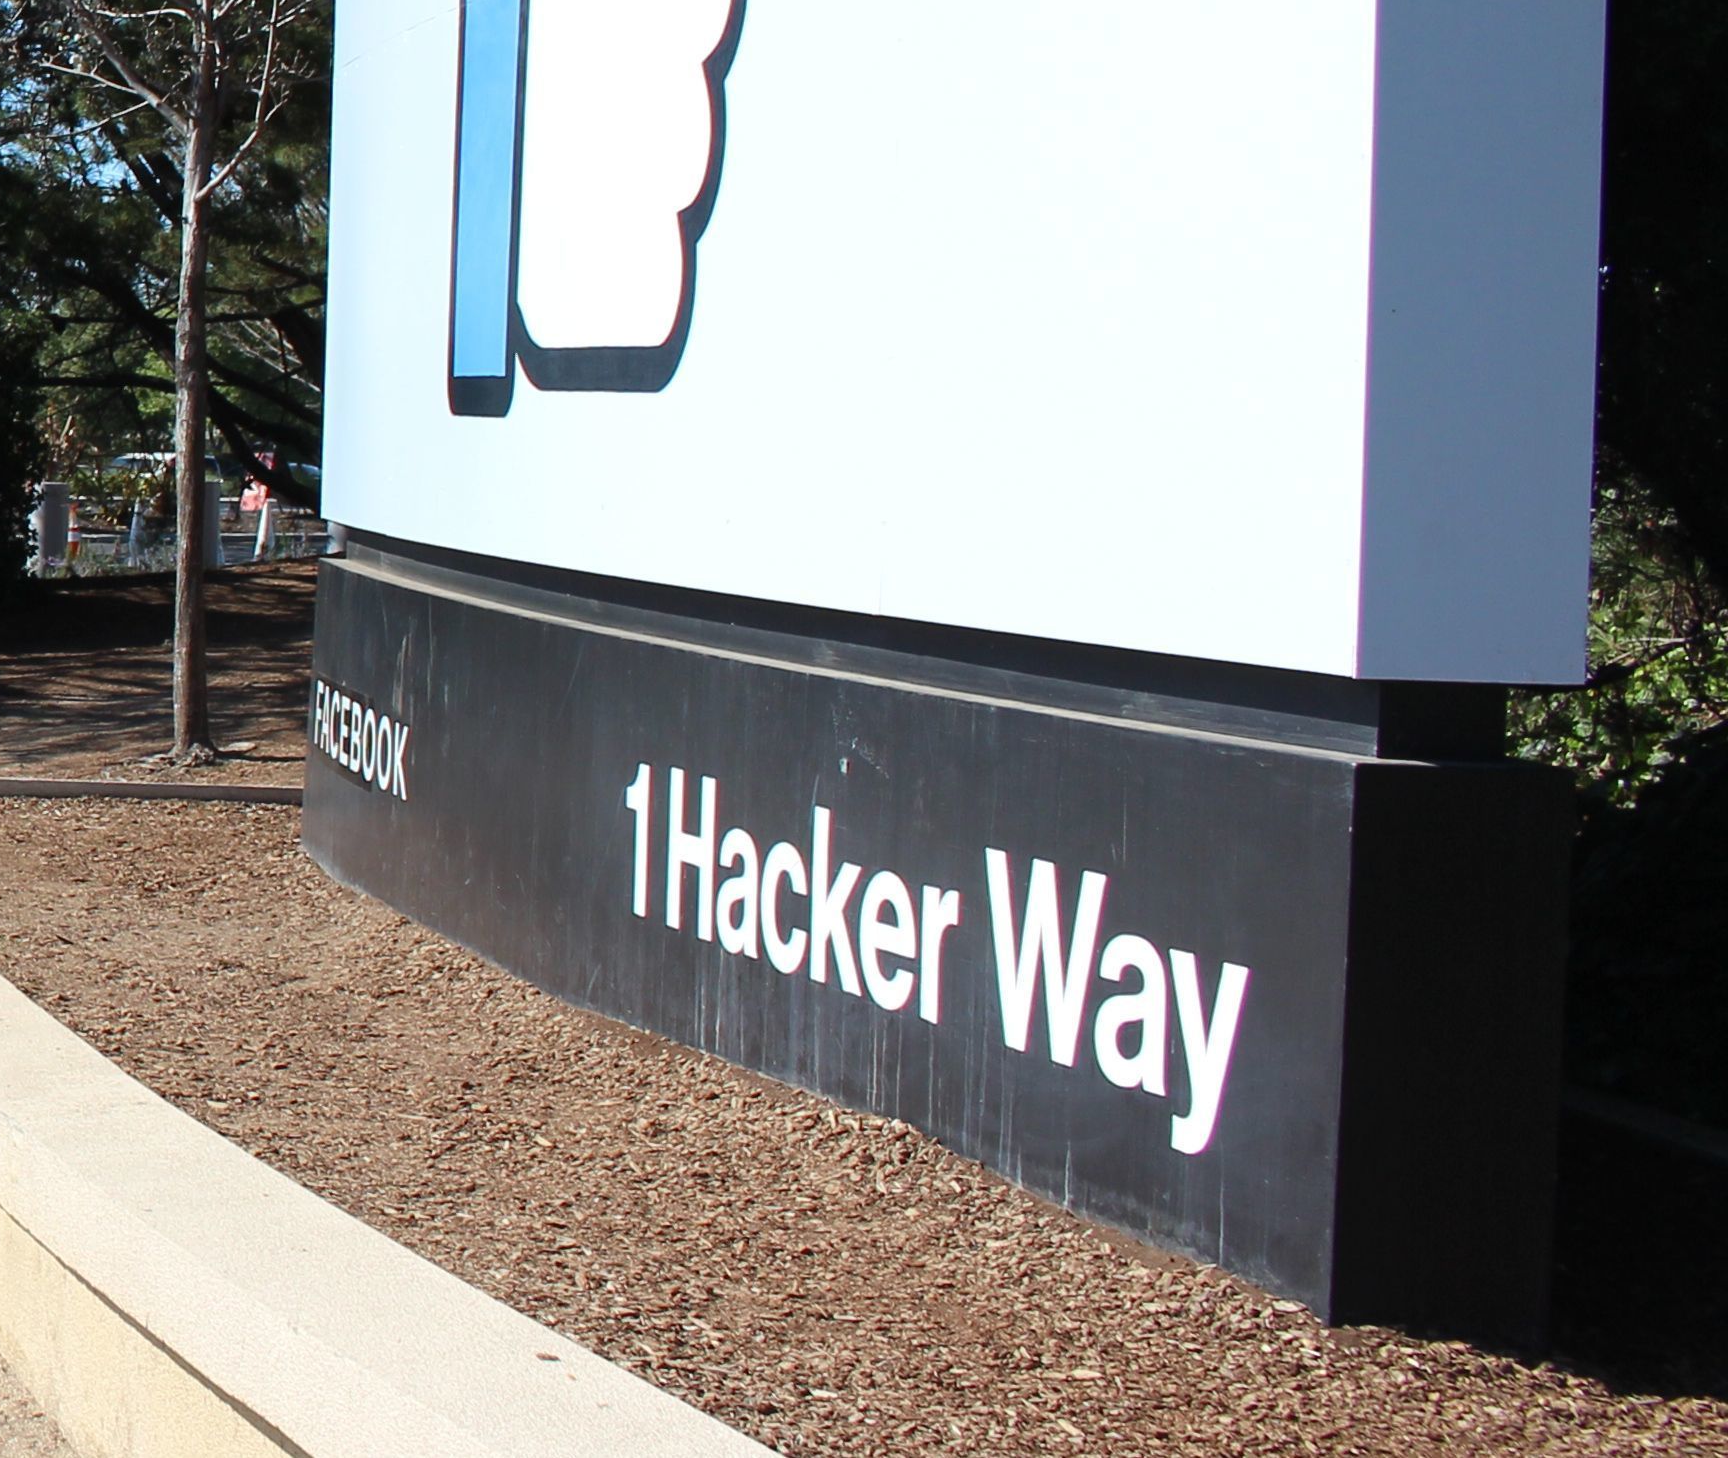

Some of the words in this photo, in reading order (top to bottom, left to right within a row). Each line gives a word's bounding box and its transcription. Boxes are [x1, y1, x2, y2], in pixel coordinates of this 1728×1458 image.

[314, 680, 409, 801] FACEBOOK
[625, 763, 651, 917] 1
[666, 767, 961, 1025] Hacker
[985, 847, 1249, 1155] Way
